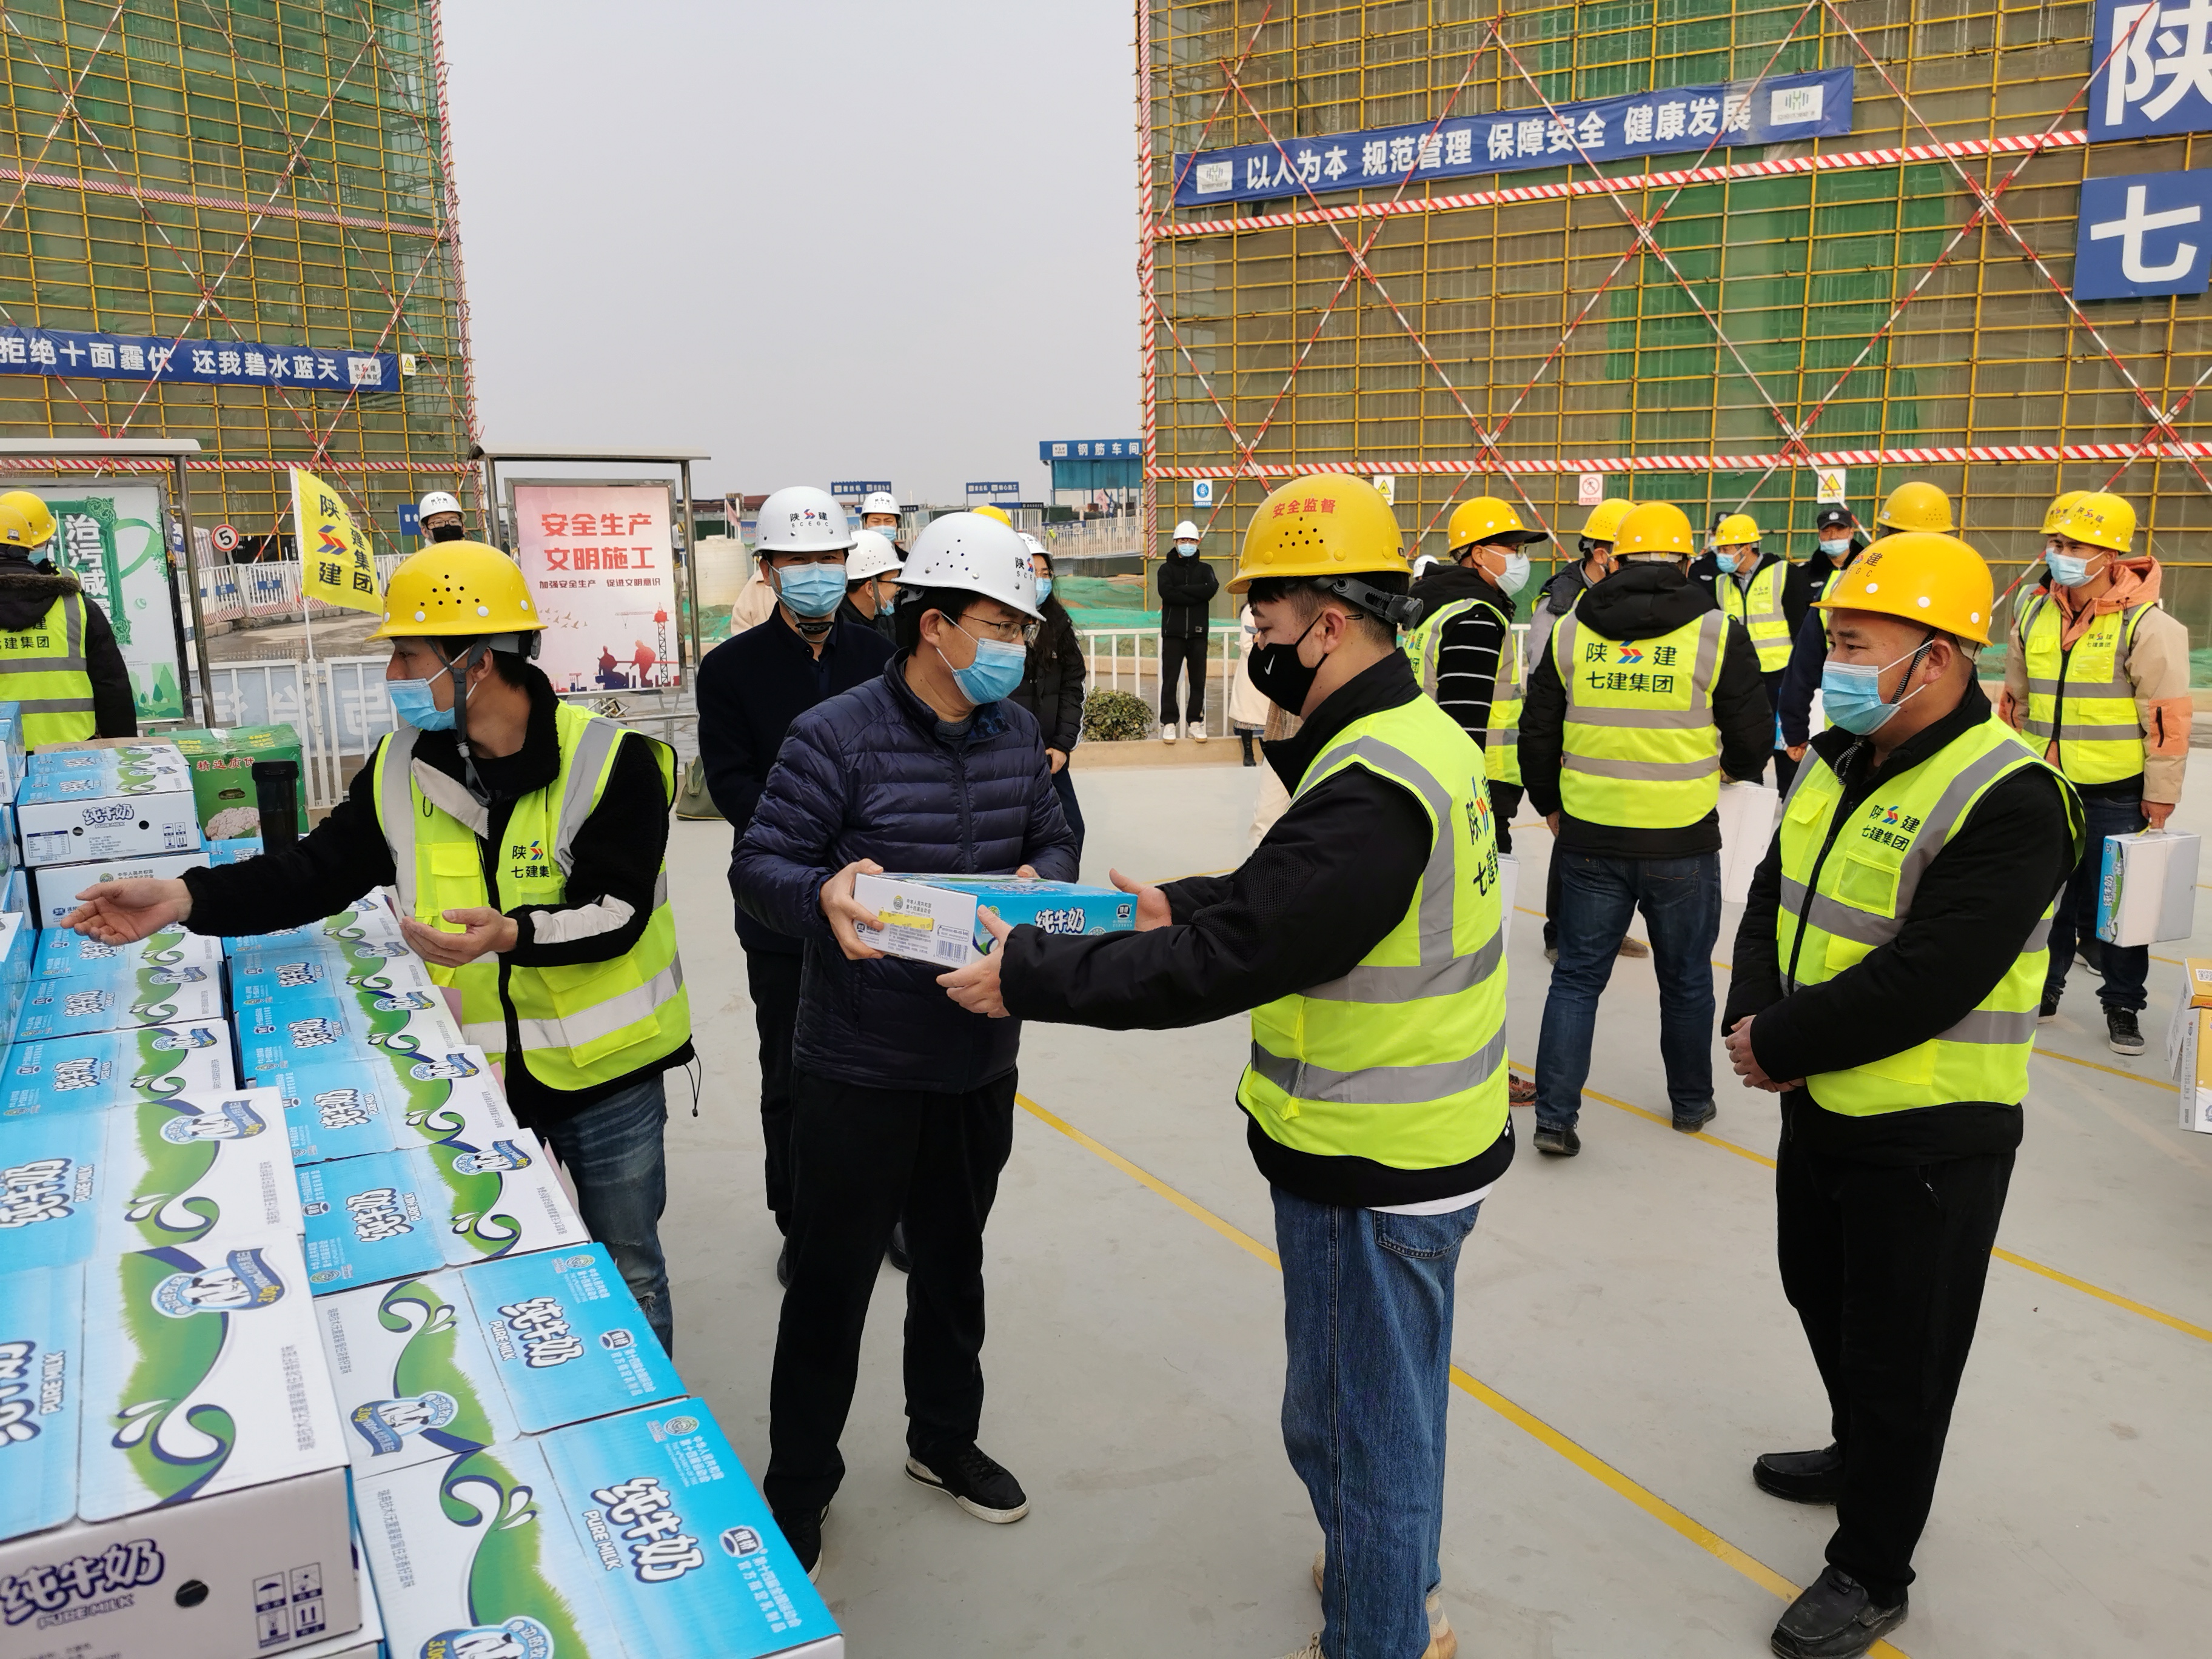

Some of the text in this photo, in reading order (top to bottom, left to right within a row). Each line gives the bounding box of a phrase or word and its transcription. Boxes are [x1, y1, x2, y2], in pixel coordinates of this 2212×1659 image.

[2105, 0, 2212, 126] 陕
[1247, 95, 1751, 189] 以人为本 规范管理 保障安全 健康发展
[2090, 185, 2200, 283] 七
[0, 335, 340, 382] 拒绝十面霾伏 还我碧水蓝天
[1078, 442, 1139, 456] 钢筋车间
[790, 513, 800, 521] 陕
[1272, 497, 1335, 518] 安全监督
[219, 531, 232, 546] 5
[541, 512, 652, 537] 安全生产
[319, 494, 342, 586] 陕 建
[344, 512, 374, 595] 建集团
[545, 547, 655, 572] 文明施工
[1864, 552, 1884, 566] 建
[539, 577, 661, 589] 加强安全生产 促进文明意识
[1586, 643, 1677, 666] 陕 建
[1586, 672, 1674, 693] 七建集团
[82, 803, 134, 825] 纯牛奶
[1870, 805, 1921, 834] 陕 建
[512, 845, 527, 860] 陕
[1862, 825, 1910, 852] 七建集团
[1034, 907, 1085, 934] 纯牛奶
[52, 1057, 100, 1091] 纯牛奶
[313, 1088, 372, 1129] 纯牛奶
[346, 1188, 414, 1242] 纯牛奶
[497, 1296, 583, 1368] 纯牛奶
[583, 1510, 623, 1570] PURE MILK
[591, 1477, 704, 1583] 纯牛奶
[0, 1538, 164, 1626] 纯牛奶
